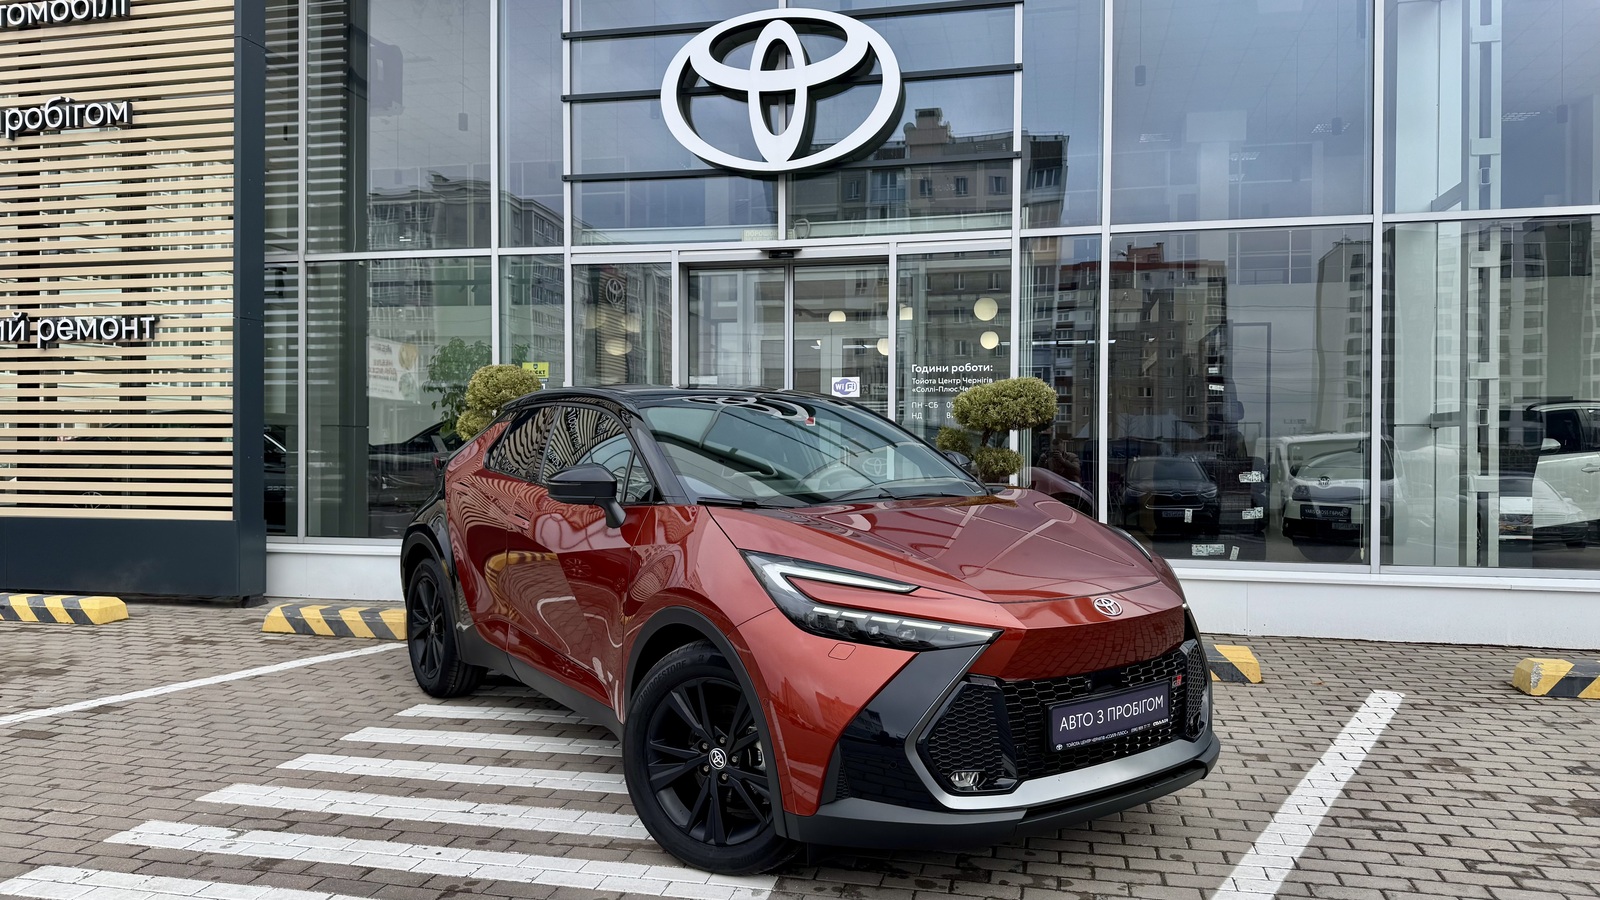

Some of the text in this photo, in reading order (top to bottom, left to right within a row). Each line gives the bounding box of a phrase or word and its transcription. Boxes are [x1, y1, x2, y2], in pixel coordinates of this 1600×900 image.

[37, 316, 155, 348] ремонт
[911, 363, 993, 374] Години роботи:
[938, 377, 961, 385] Центр
[911, 412, 923, 420] НД
[1059, 711, 1094, 732] АВТО
[1107, 695, 1164, 722] ПРОБІГОМ
